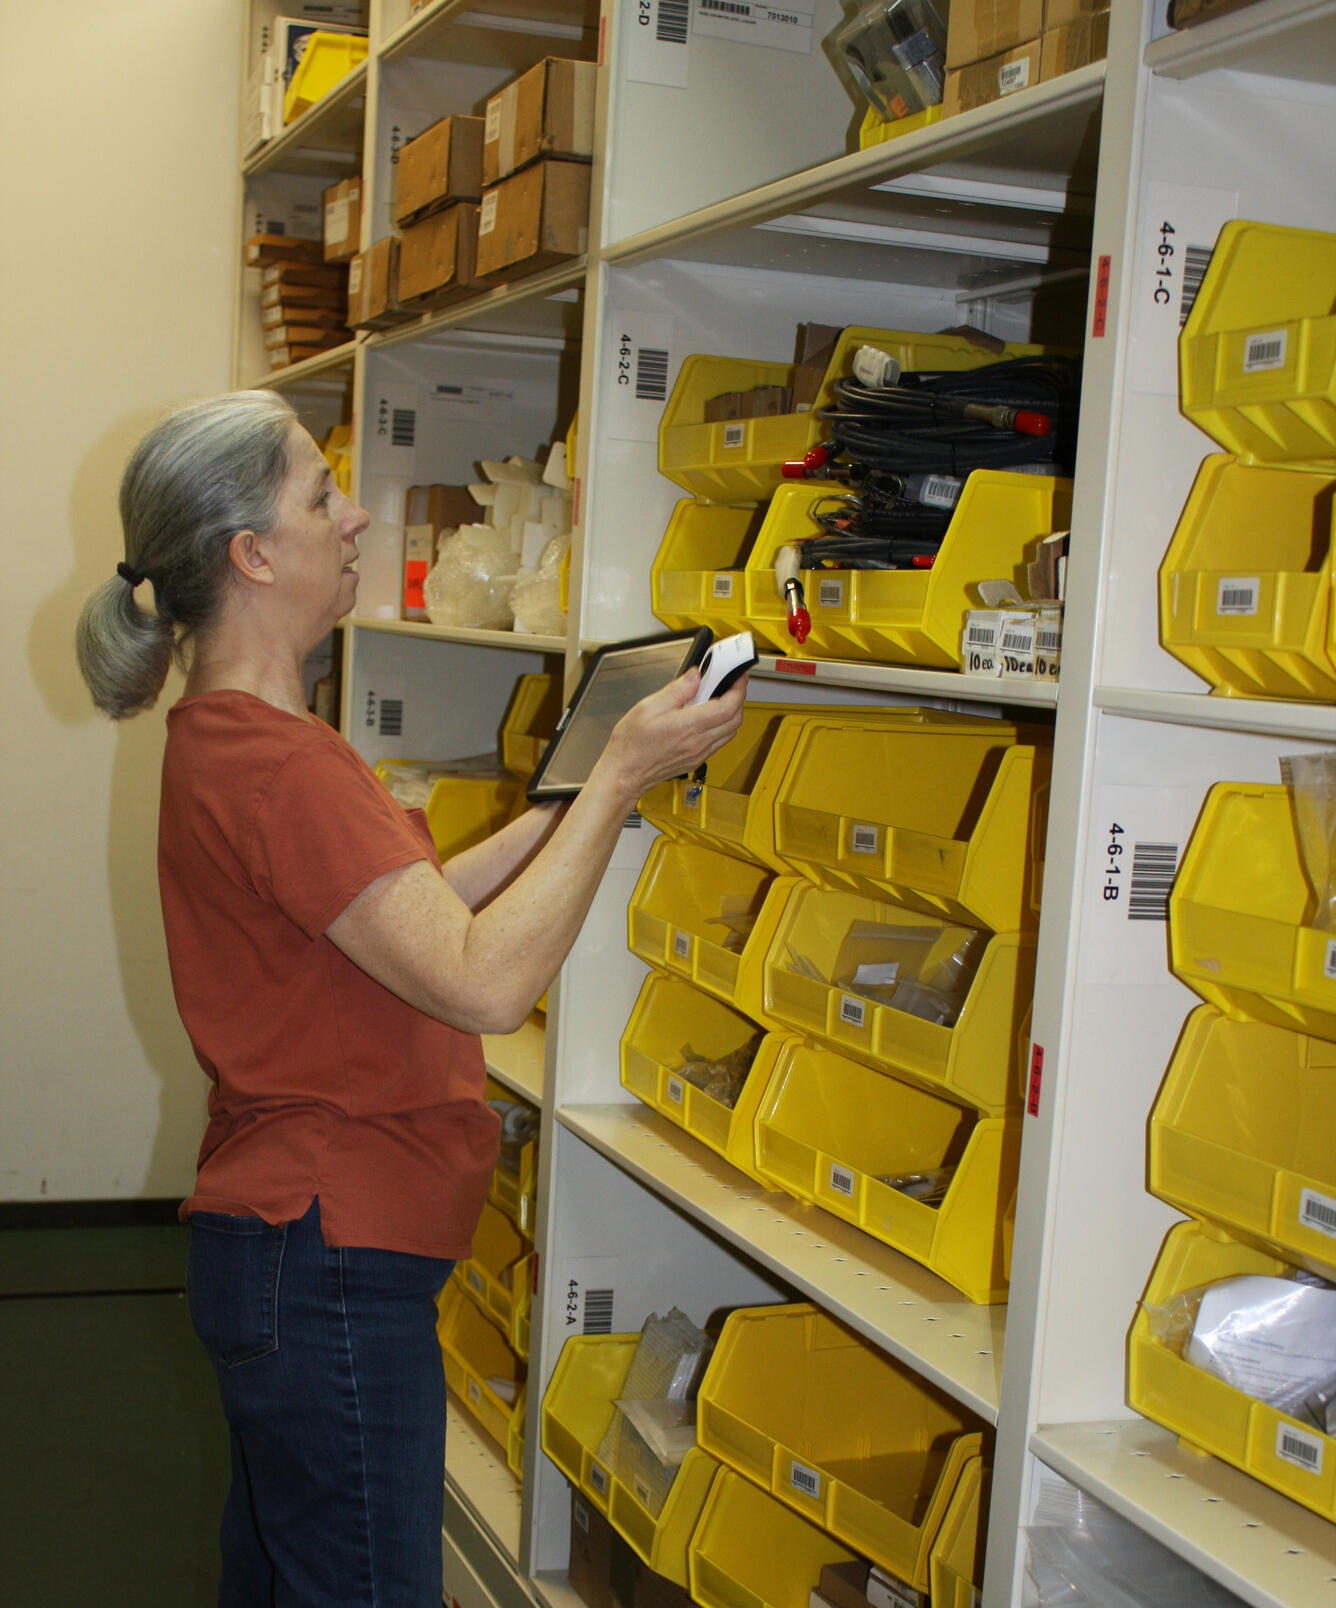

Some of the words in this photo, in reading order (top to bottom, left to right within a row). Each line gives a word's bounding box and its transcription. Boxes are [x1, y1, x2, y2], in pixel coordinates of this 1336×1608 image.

[1153, 221, 1175, 304] 4-6-1-C
[617, 333, 632, 385] 4-6-2-C
[1103, 822, 1125, 901] 4-6-1-B
[565, 1279, 579, 1326] 4-6-2-A
